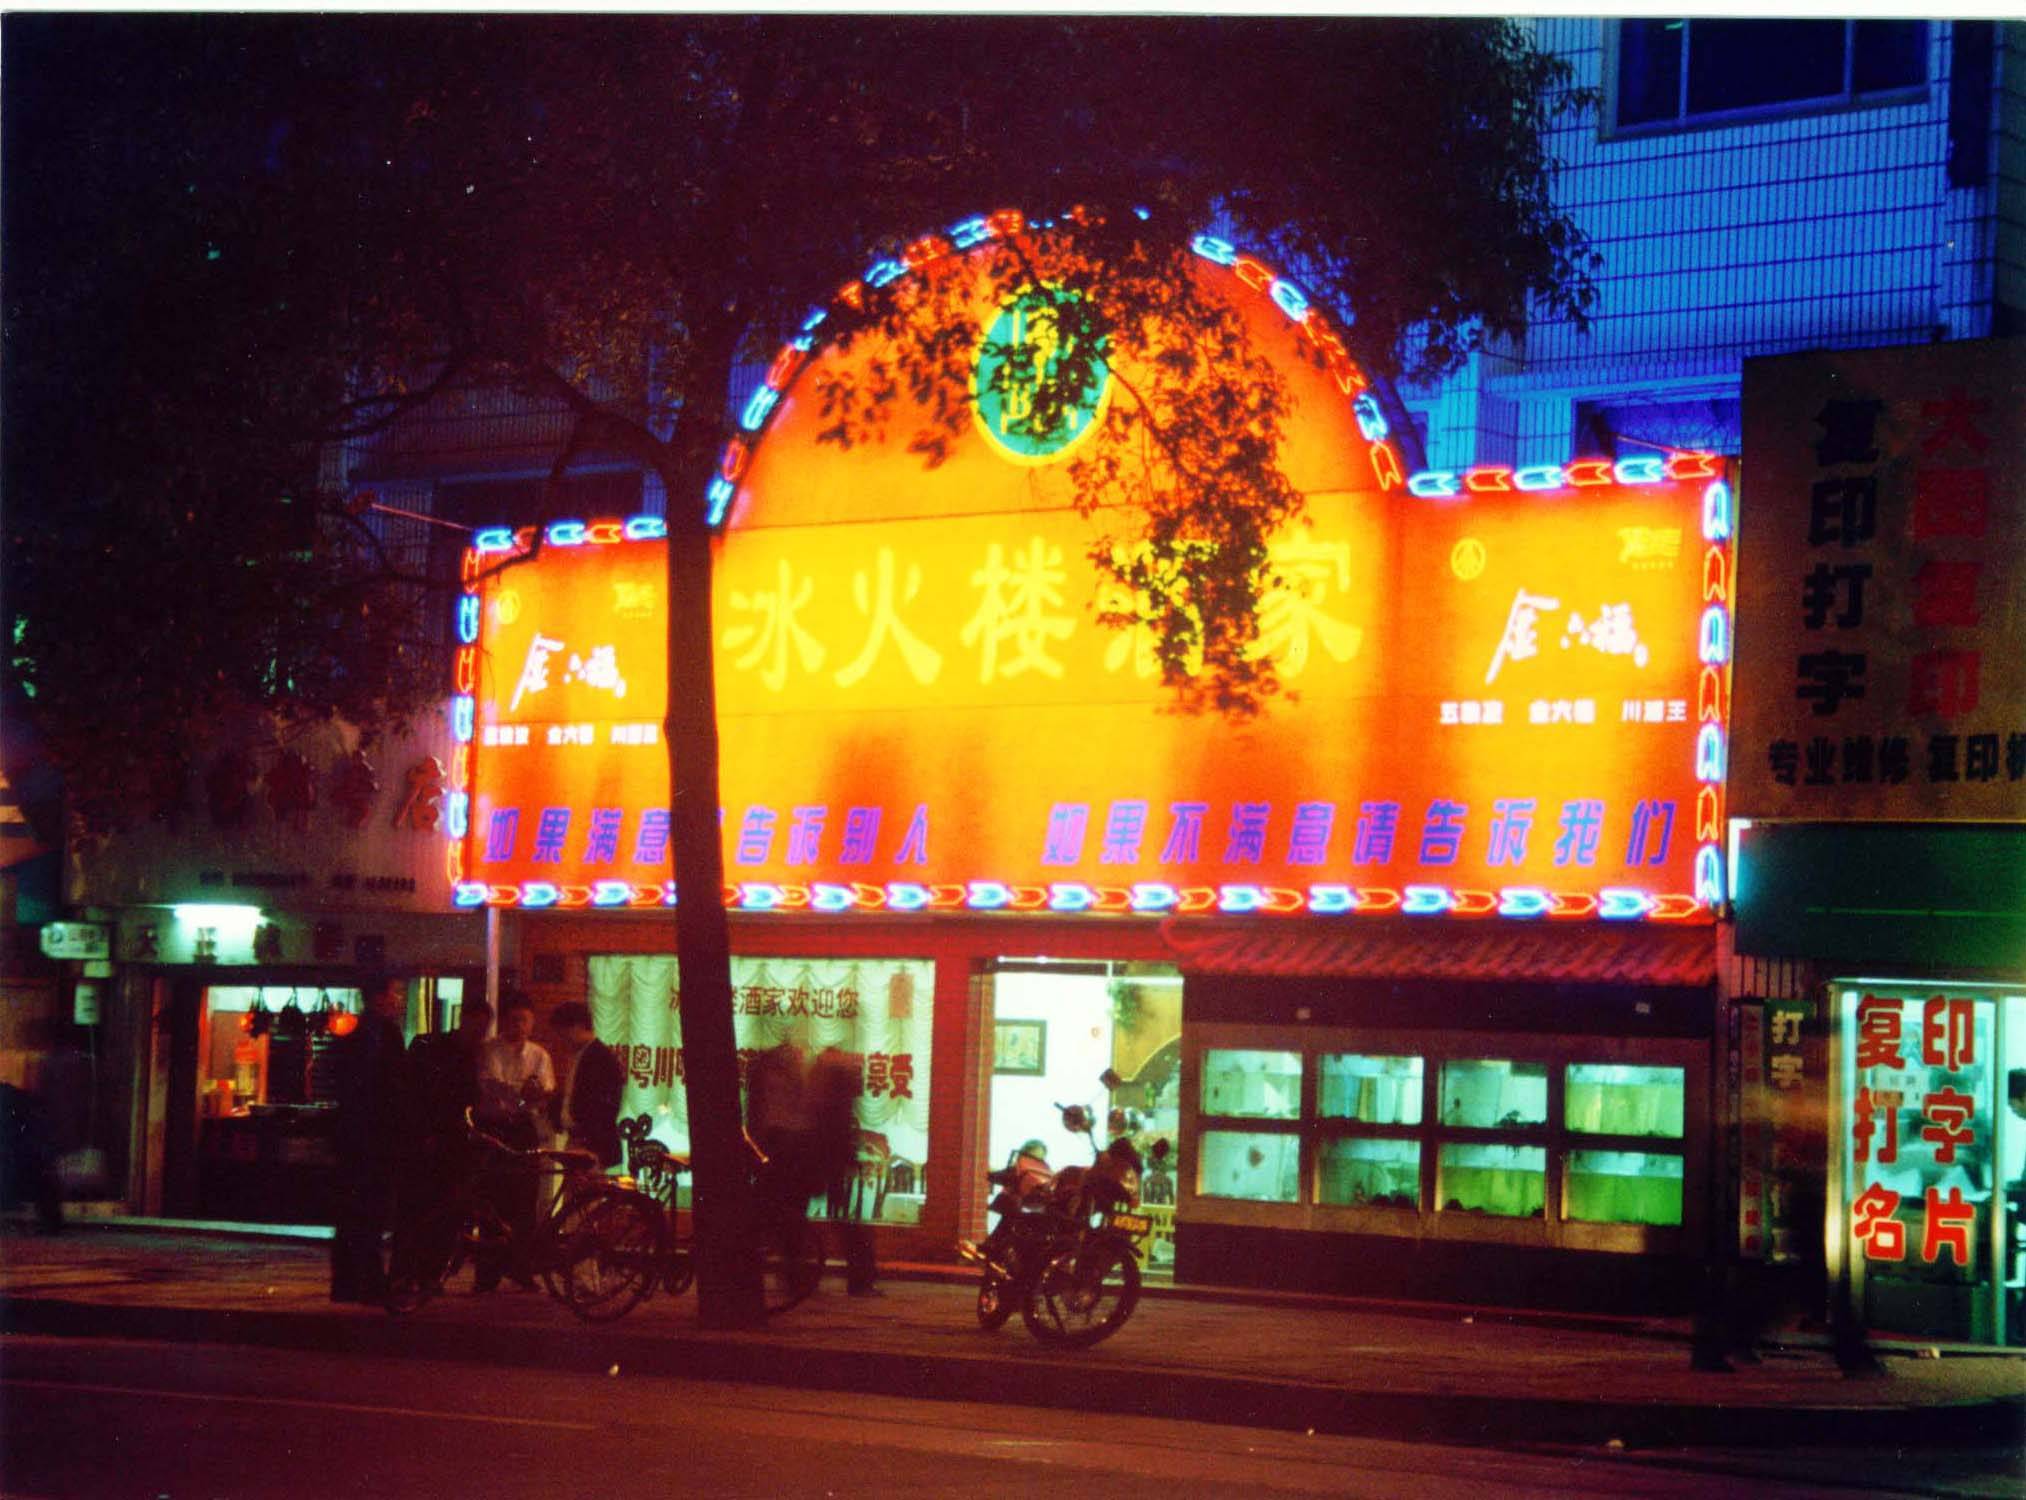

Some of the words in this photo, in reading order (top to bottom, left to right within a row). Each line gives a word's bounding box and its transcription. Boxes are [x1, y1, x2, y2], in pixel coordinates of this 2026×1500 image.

[483, 802, 932, 866] 如果满意告诉别人
[1040, 800, 1677, 866] 如果不满意请告诉我们
[1771, 1009, 1804, 1089] 打字
[1856, 993, 1976, 1073] 复印
[1853, 1086, 1976, 1165] 打字
[1853, 1181, 1976, 1266] 名片
